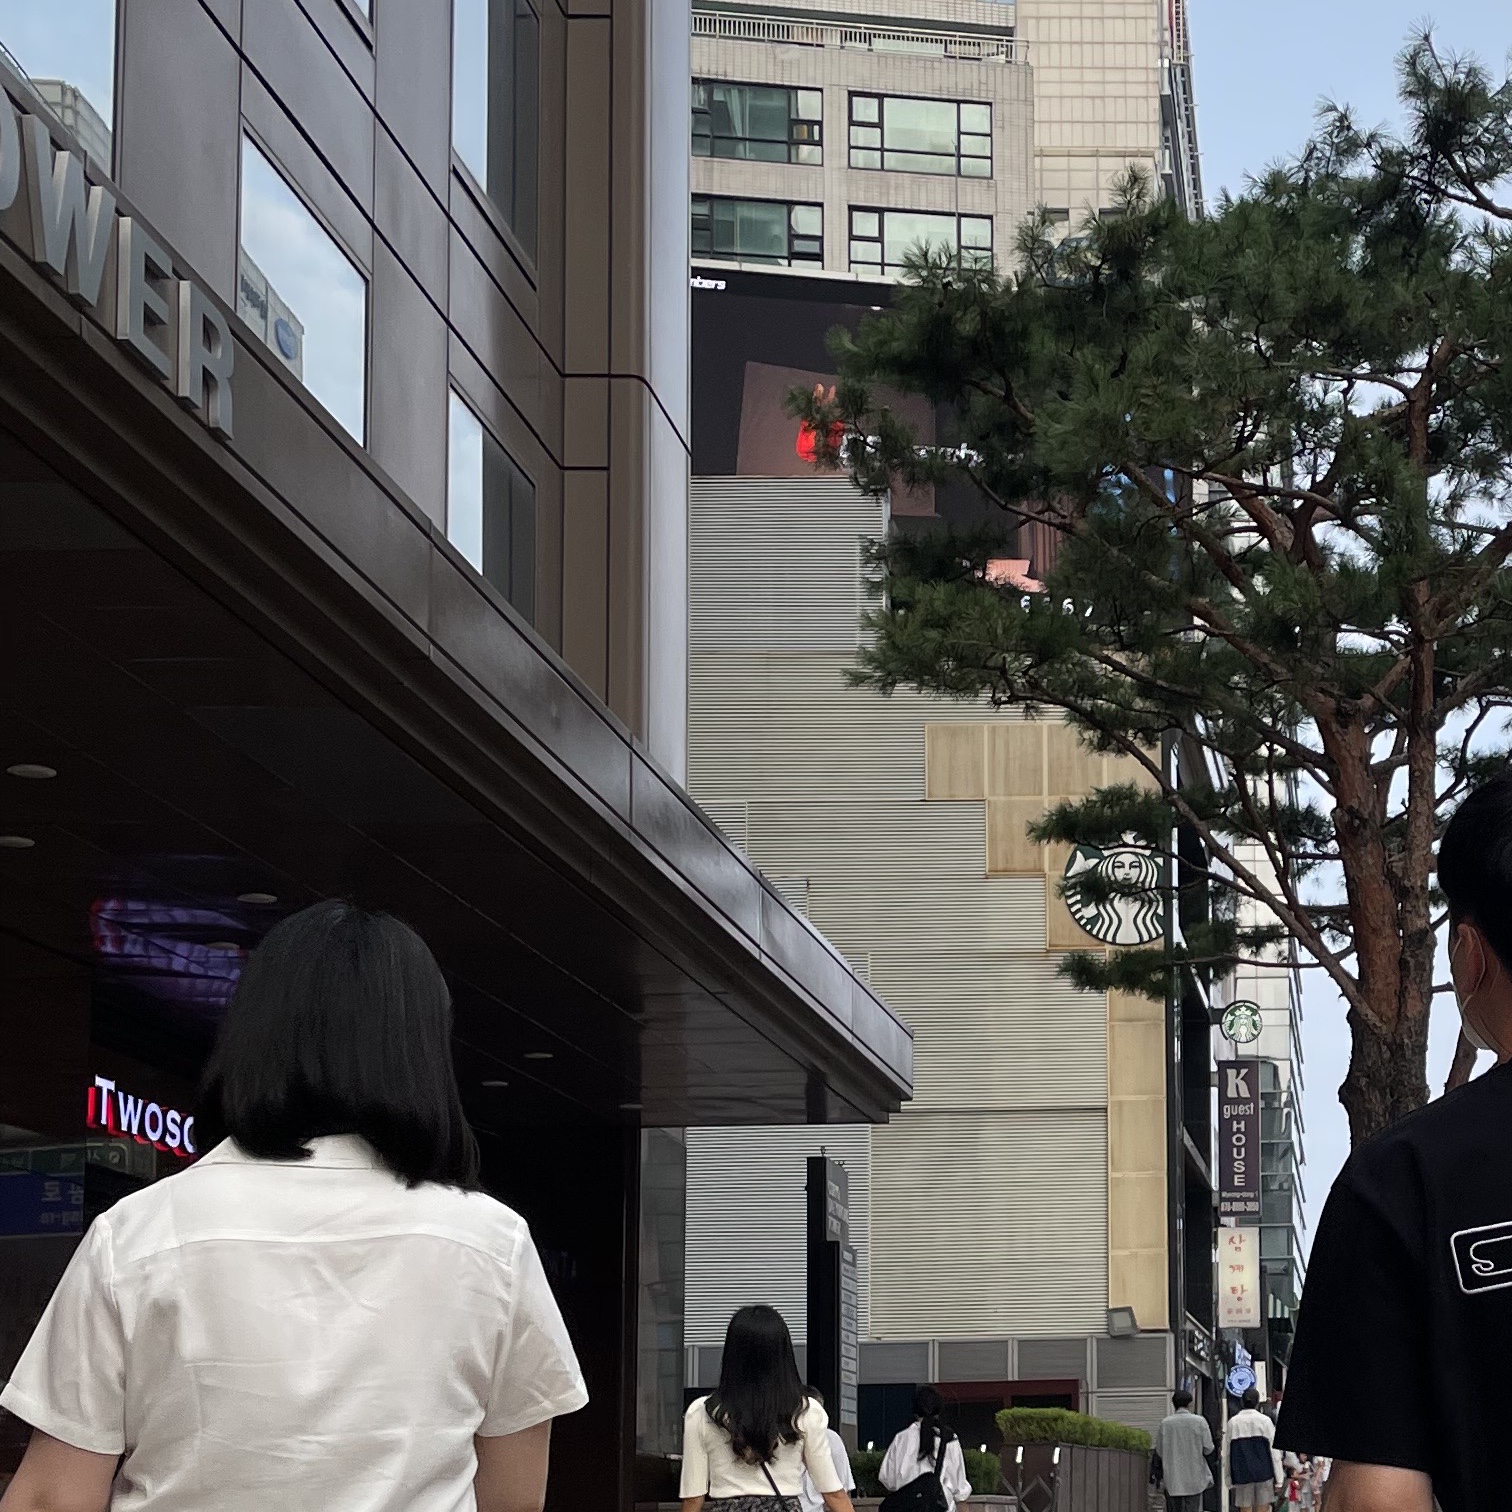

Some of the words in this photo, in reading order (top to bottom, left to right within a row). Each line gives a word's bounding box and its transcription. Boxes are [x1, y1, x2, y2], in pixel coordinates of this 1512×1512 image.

[1226, 1068, 1251, 1098] K
[1223, 1102, 1255, 1119] guest
[1231, 1120, 1247, 1186] HOUSE
